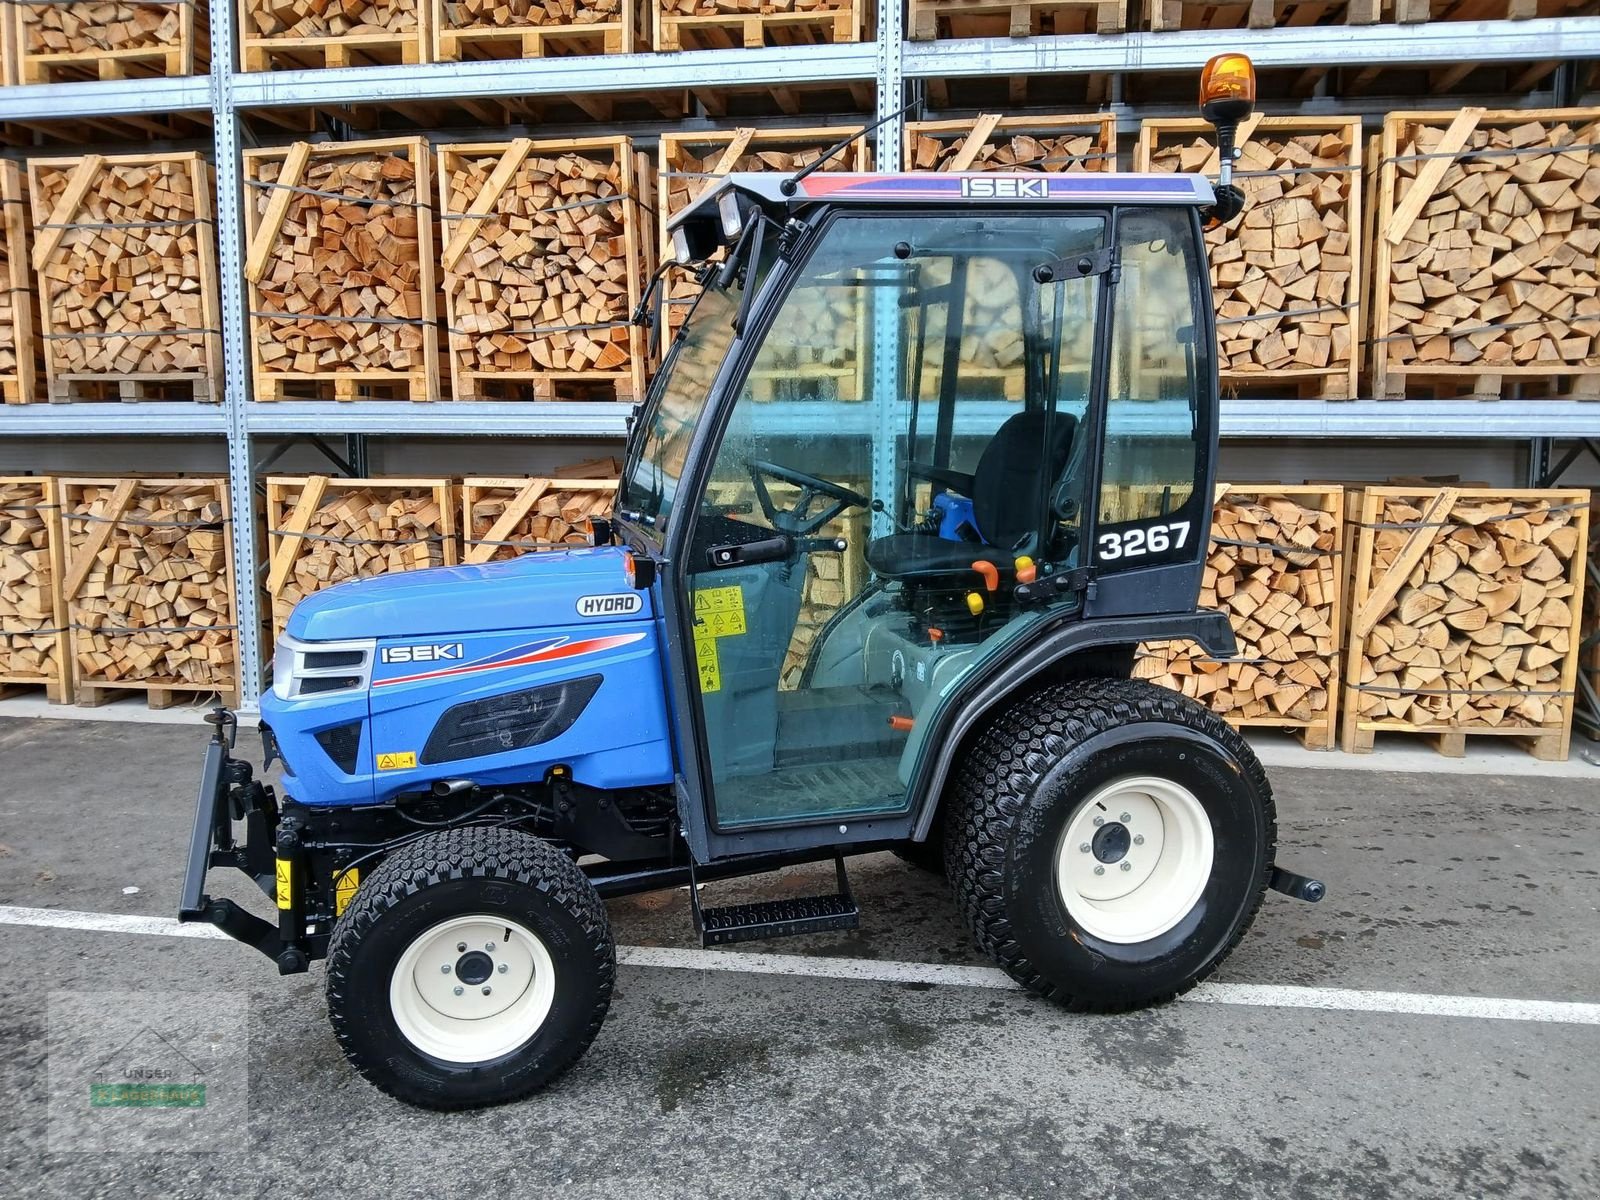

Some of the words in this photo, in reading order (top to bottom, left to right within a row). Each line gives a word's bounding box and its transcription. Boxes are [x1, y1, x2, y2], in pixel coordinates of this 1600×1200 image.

[961, 177, 1049, 198] ISEKI
[1099, 521, 1190, 560] 3267
[583, 597, 635, 613] HYDRO
[381, 643, 464, 664] ISEKI
